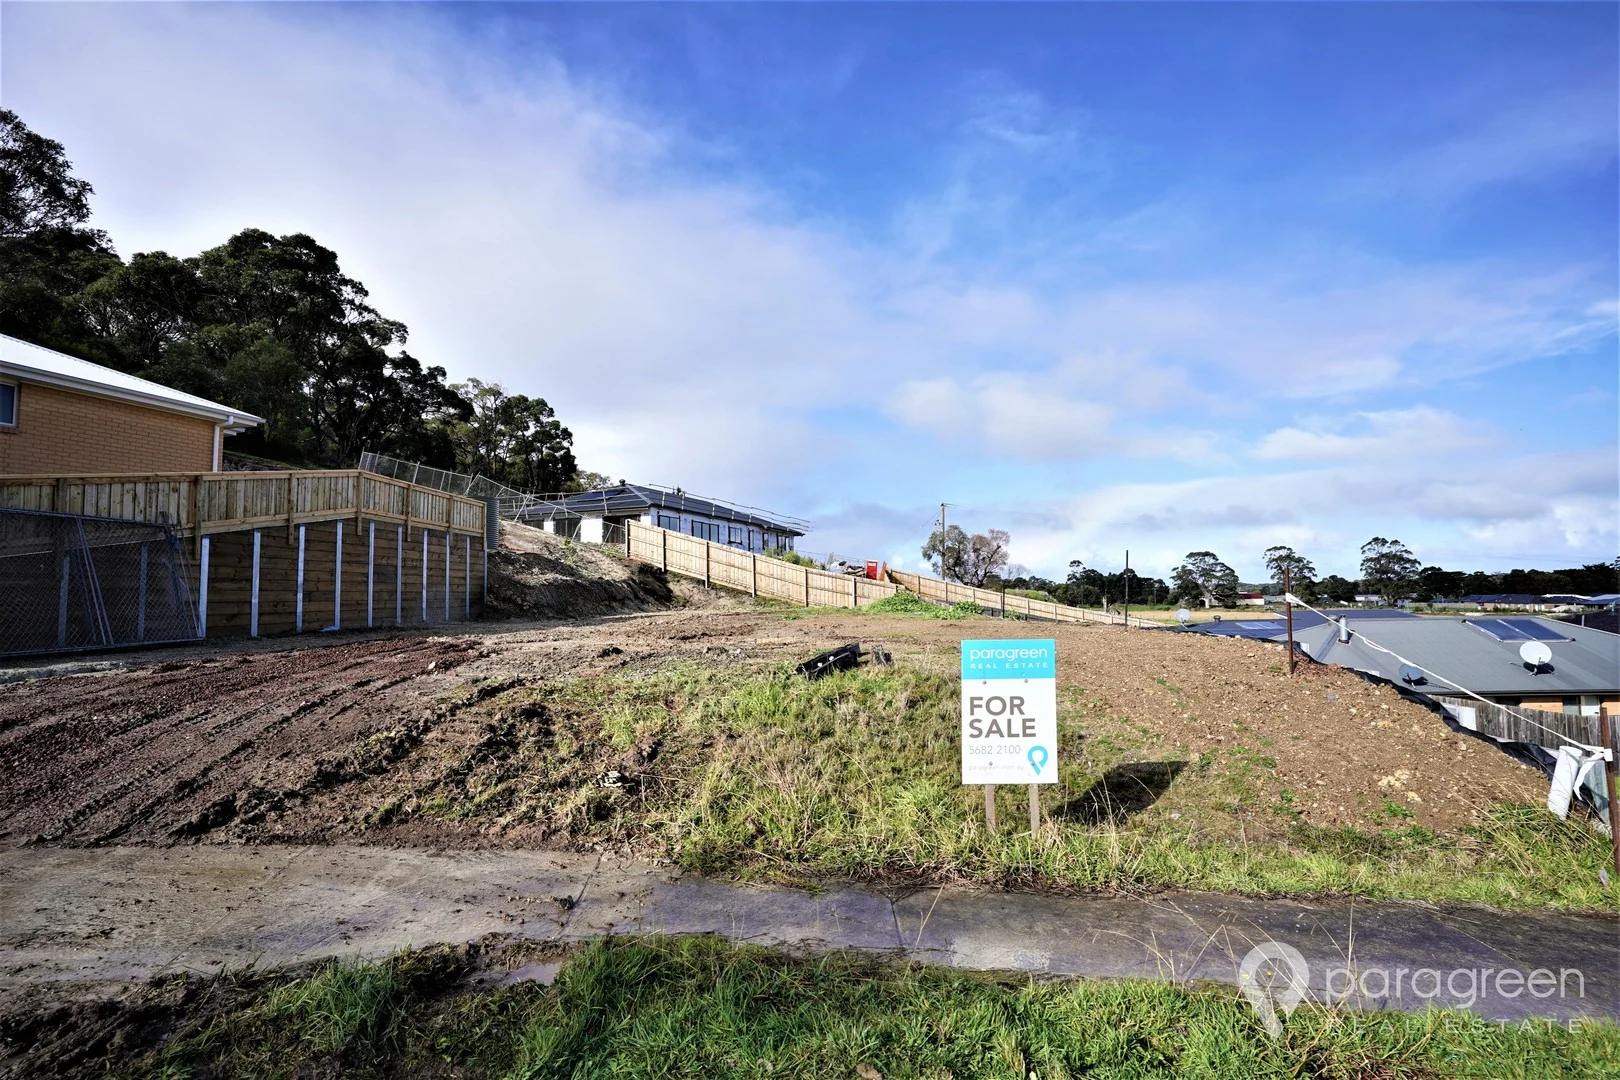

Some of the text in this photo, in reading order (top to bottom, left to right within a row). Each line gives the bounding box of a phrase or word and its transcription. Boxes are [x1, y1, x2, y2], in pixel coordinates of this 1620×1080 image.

[969, 648, 1048, 661] paragreen
[969, 696, 1025, 716] FOR
[968, 718, 1036, 738] SALE
[969, 745, 1021, 755] 5682 2100
